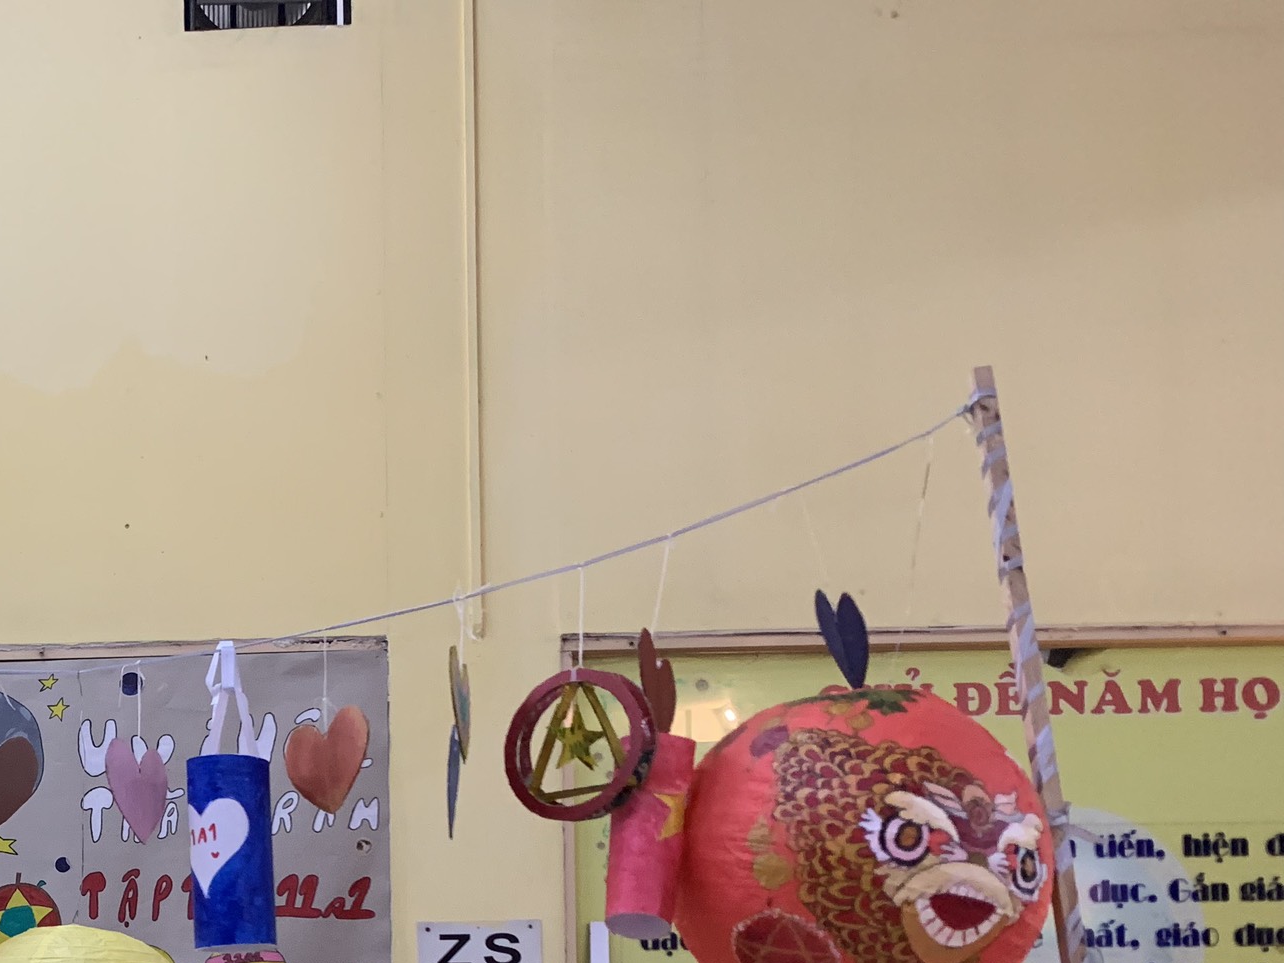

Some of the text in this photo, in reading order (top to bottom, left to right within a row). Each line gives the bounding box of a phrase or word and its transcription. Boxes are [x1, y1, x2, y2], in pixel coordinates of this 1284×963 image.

[1048, 668, 1182, 715] NĂM
[1200, 677, 1281, 719] HỌ
[1182, 831, 1250, 863] hiện
[80, 868, 173, 928] TẬP
[1156, 921, 1220, 948] giáo
